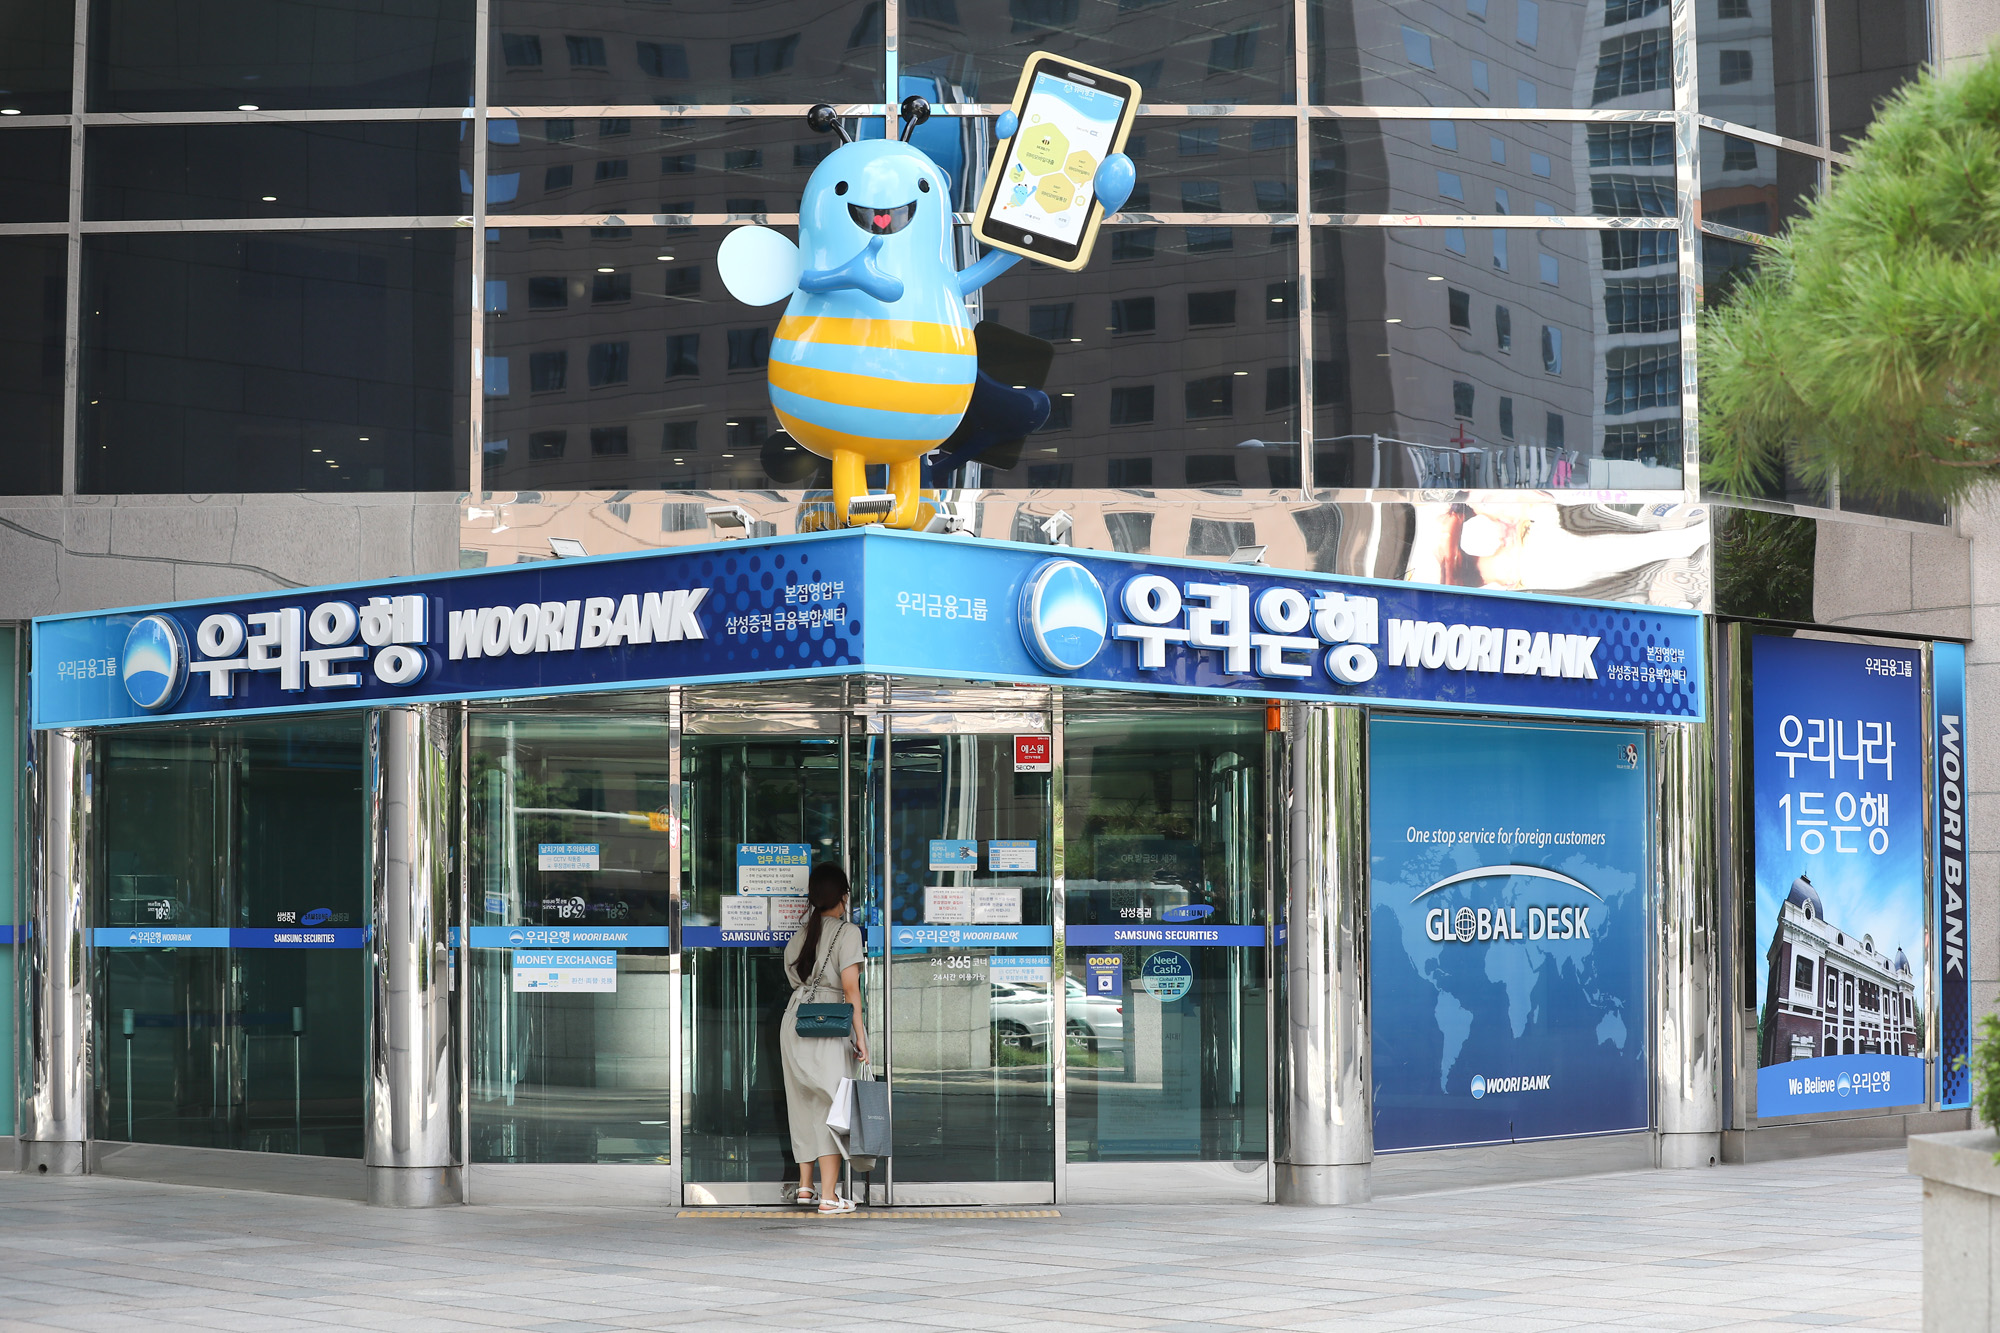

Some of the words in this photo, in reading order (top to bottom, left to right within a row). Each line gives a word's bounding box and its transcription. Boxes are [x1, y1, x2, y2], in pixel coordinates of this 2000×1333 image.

[785, 580, 846, 604] 본점영업부
[896, 591, 988, 622] 우리금융그룹
[448, 600, 580, 660] WOORI
[580, 587, 710, 650] BANK
[725, 614, 773, 636] 삼성증권
[774, 607, 846, 632] 금융복합센터
[1113, 574, 1379, 686] 우리은행
[190, 594, 428, 697] 우리은행
[1388, 618, 1502, 674] WOORI
[1503, 628, 1602, 680] BANK
[1646, 645, 1686, 664] 본점영업부
[57, 657, 117, 681] 우리금융그룹
[1607, 664, 1640, 682] 삼성증권
[1640, 666, 1687, 685] 금융복합센터
[1865, 657, 1913, 677] 우리금융그룹
[1775, 714, 1897, 781] 우리나라
[1941, 714, 1962, 852] WOORI
[1779, 791, 1889, 855] 1등은행
[1407, 826, 1430, 843] One
[1431, 828, 1456, 847] stop
[1458, 828, 1495, 844] service
[1497, 828, 1513, 844] for
[1514, 828, 1551, 848] foreign
[1554, 830, 1606, 845] customers
[740, 845, 790, 854] 주택도시기금
[757, 855, 773, 864] 업무
[775, 855, 807, 864] 취급은행
[557, 896, 586, 918] 1899
[1119, 907, 1152, 919] 삼성증권
[1425, 906, 1523, 943] GLOBAL
[1528, 906, 1590, 940] DESK
[1944, 856, 1964, 979] BANK
[137, 931, 162, 944] 우리은행
[162, 934, 177, 942] WOORI
[177, 933, 192, 941] BANK
[274, 933, 302, 943] SAMSUNG
[303, 933, 335, 943] SECURITIES
[525, 930, 570, 944] 우리은행
[572, 933, 602, 941] WOORI
[602, 933, 629, 941] BANK
[721, 931, 770, 941] SAMSUNG
[915, 930, 960, 943] 우리은행
[962, 932, 992, 940] WOORI
[992, 931, 1019, 940] BANK
[1114, 930, 1163, 940] SAMSUNG
[1165, 930, 1219, 941] SECURITIES
[516, 955, 554, 965] MONEY
[556, 955, 613, 965] EXCHANGE
[972, 957, 987, 967] 코너
[1019, 957, 1050, 965] 주의하세요
[1153, 955, 1178, 965] Need
[1153, 964, 1182, 974] Cash?
[933, 973, 956, 981] 24시간
[958, 973, 986, 981] 이용가능
[1486, 1077, 1520, 1094] WOORI
[1521, 1075, 1551, 1091] BANK
[1789, 1079, 1802, 1095] We
[1804, 1077, 1835, 1094] Believe
[1852, 1071, 1891, 1096] 우리은행
